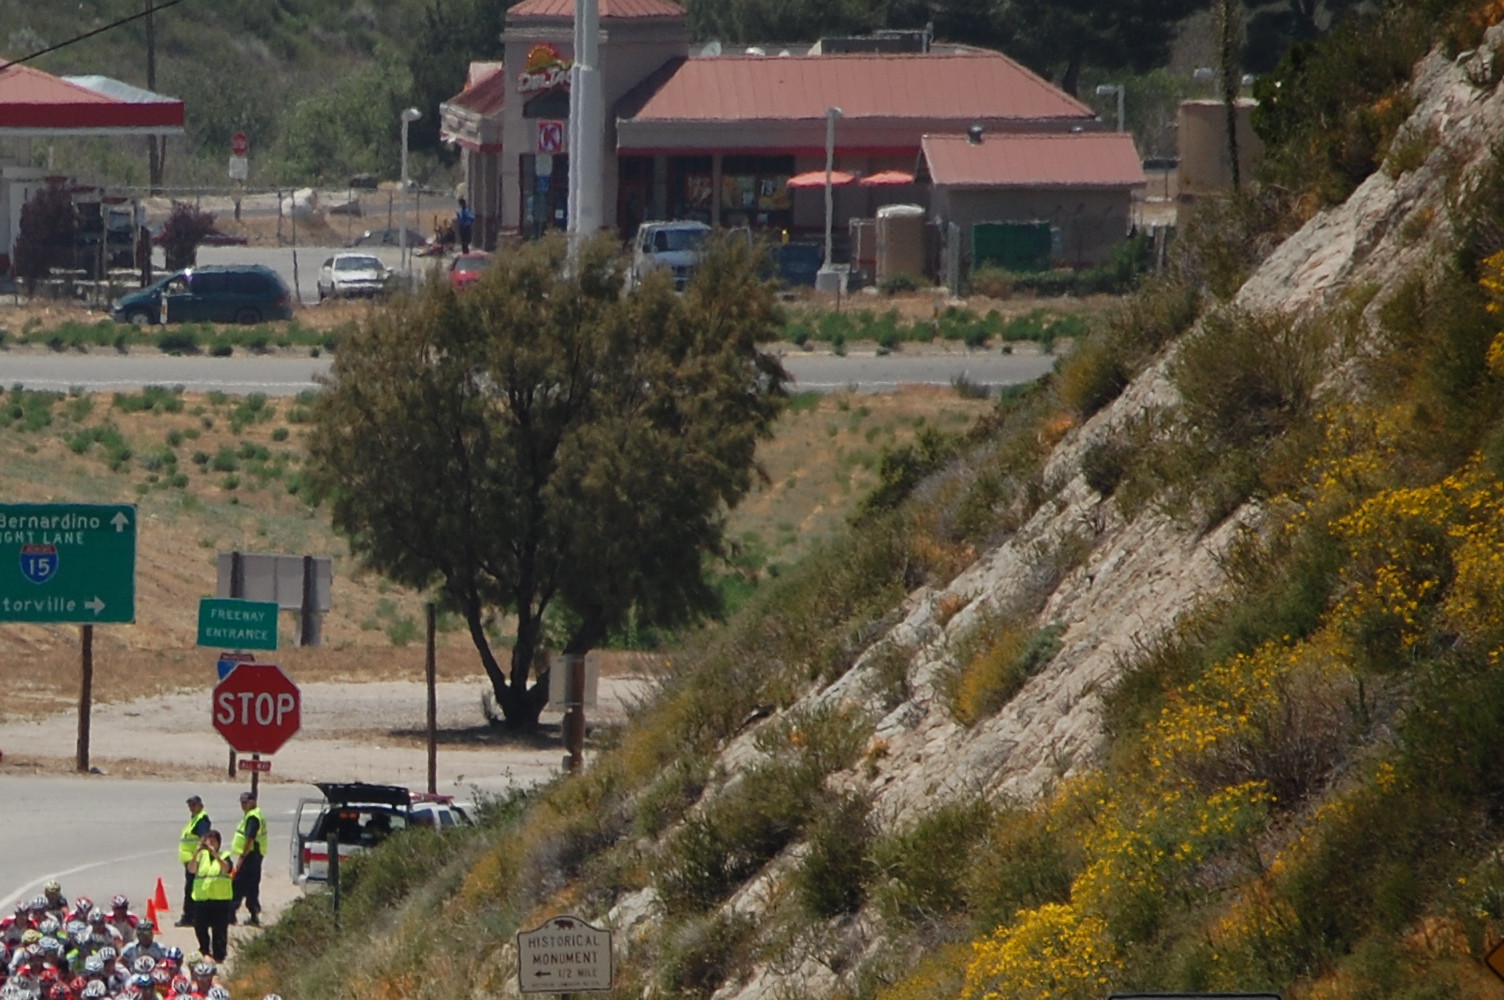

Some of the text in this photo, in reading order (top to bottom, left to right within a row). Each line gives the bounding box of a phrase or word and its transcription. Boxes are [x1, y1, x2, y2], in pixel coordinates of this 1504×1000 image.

[518, 67, 572, 92] DEL TAC
[42, 532, 85, 545] LANE
[28, 558, 50, 576] 15
[210, 608, 265, 622] FREEWAY
[205, 627, 269, 641] ENTRANCE
[216, 692, 295, 726] STOP
[528, 934, 600, 948] HISTORICAL
[533, 951, 598, 965] MONUMENT
[558, 968, 598, 979] 1/2 MILE
